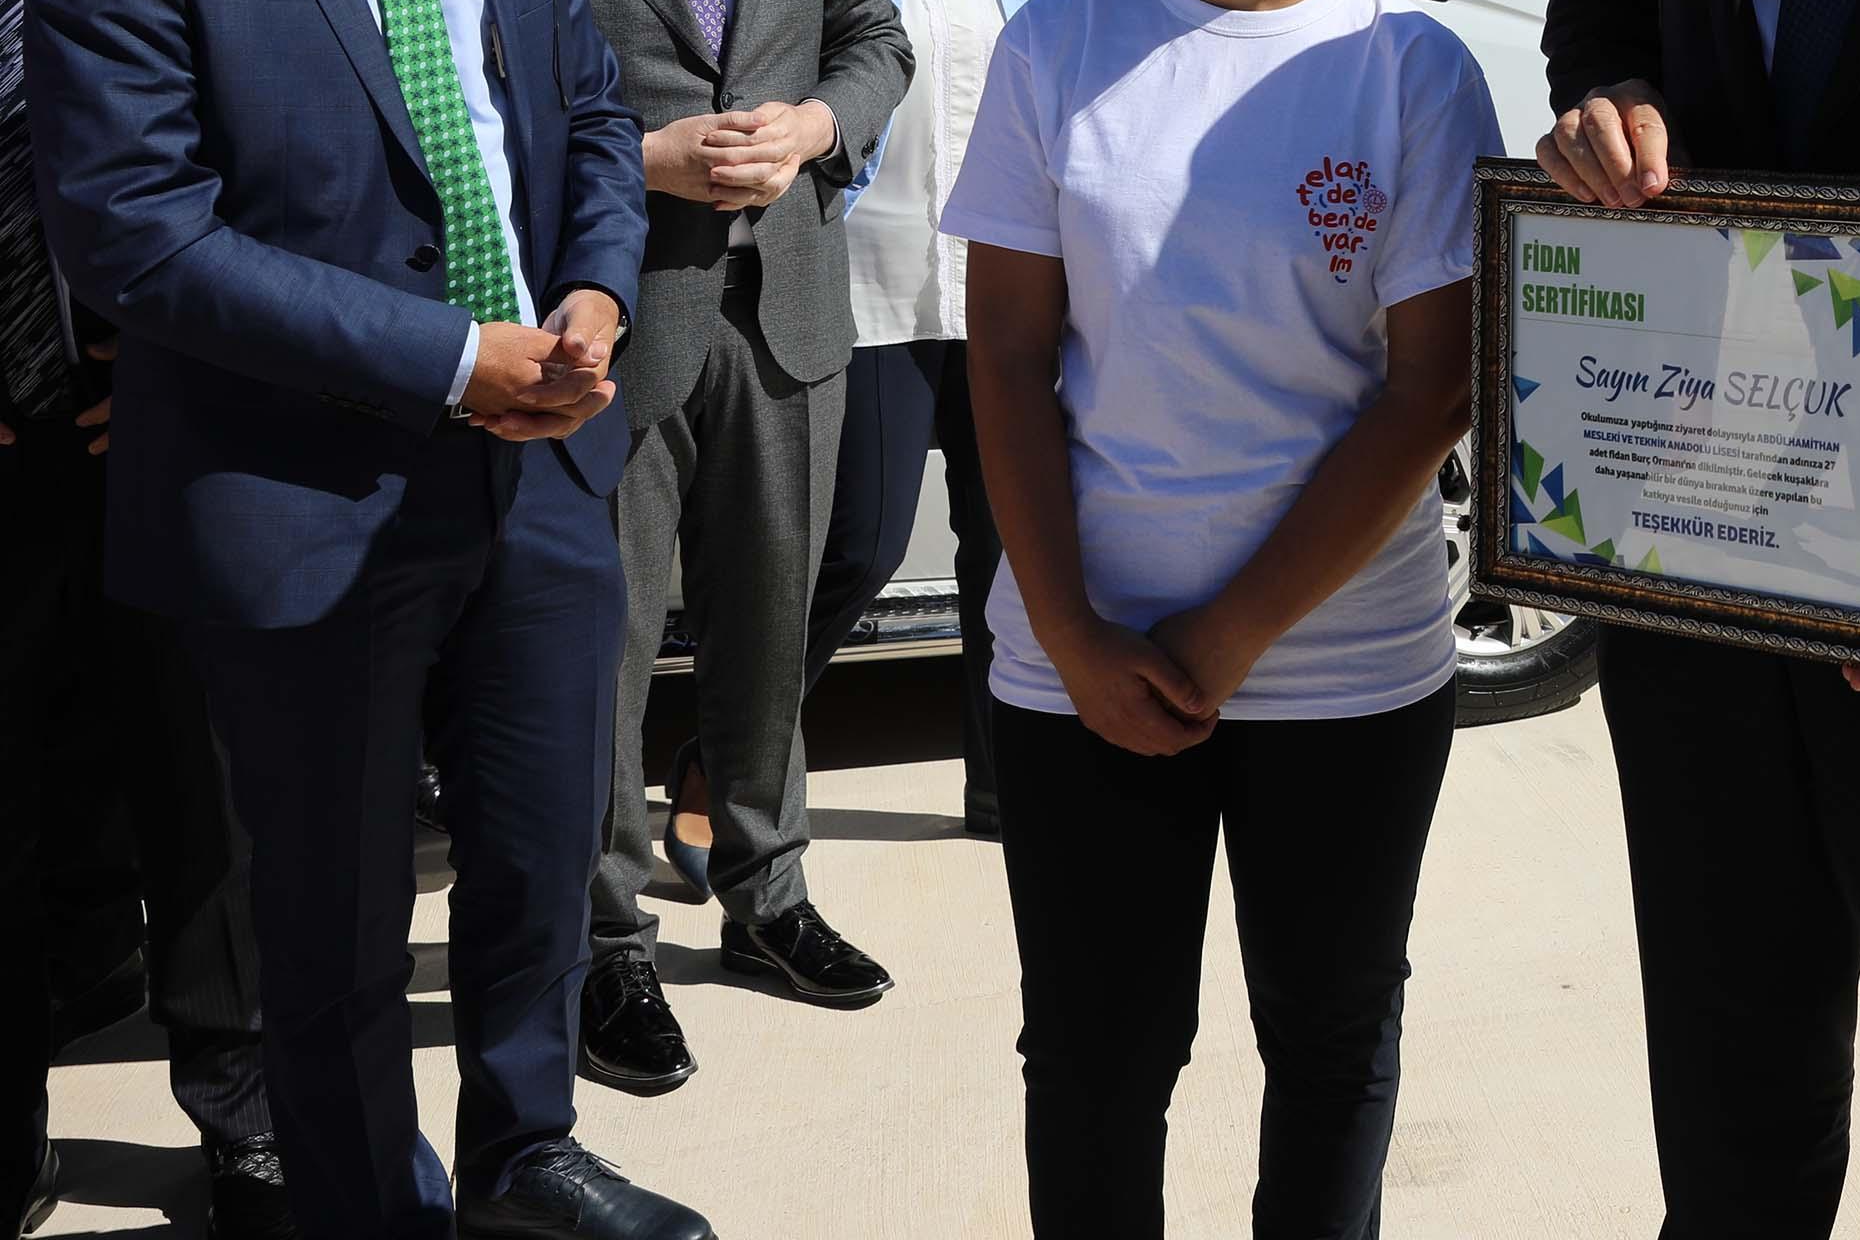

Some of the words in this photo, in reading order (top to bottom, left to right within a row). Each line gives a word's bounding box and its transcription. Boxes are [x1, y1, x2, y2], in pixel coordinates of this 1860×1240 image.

[1296, 156, 1371, 207] telafi
[1326, 182, 1358, 204] de
[1308, 208, 1349, 228] ben
[1354, 212, 1377, 232] de
[1322, 232, 1364, 253] var
[1522, 238, 1581, 275] FİDAN
[1521, 282, 1645, 322] SERTİFİKASI
[1575, 355, 1650, 402] Sayın
[1653, 363, 1716, 410] Ziya
[1723, 371, 1852, 421] SELÇUK
[1580, 411, 1629, 426] Okulumuza
[1630, 419, 1674, 433] yaptığınız
[1674, 423, 1706, 437] ziyaret
[1706, 427, 1756, 444] dolayısıyla
[1756, 433, 1841, 453] ABDÜLHAMİTHAN
[1589, 448, 1609, 458] adet
[1608, 449, 1631, 462] fidan
[1631, 453, 1652, 466] Burç
[1697, 462, 1747, 478] dikilmiştir.
[1747, 468, 1784, 482] Gelecek
[1784, 473, 1830, 489] kuşaklara
[1621, 434, 1633, 445] VE
[1633, 435, 1667, 450] TEKNİK
[1667, 441, 1712, 455] ANADOLU
[1712, 445, 1741, 459] LİSESİ
[1741, 450, 1789, 464] tarafından
[1789, 456, 1823, 470] adınıza
[1824, 460, 1837, 471] 27
[1594, 465, 1616, 477] daha
[1615, 469, 1664, 485] yaşanabilir
[1663, 474, 1677, 486] bir
[1677, 476, 1706, 491] dünya
[1705, 479, 1749, 496] bırakmak
[1748, 485, 1774, 499] üzere
[1774, 490, 1809, 504] yapılan
[1809, 495, 1823, 506] bu
[1642, 488, 1676, 504] katkıya
[1676, 493, 1703, 507] vesile
[1703, 498, 1752, 514] olduğunuz
[1751, 505, 1769, 517] için
[1631, 510, 1715, 539] TEŞEKKÜR
[1716, 524, 1781, 550] EDERİZ.
